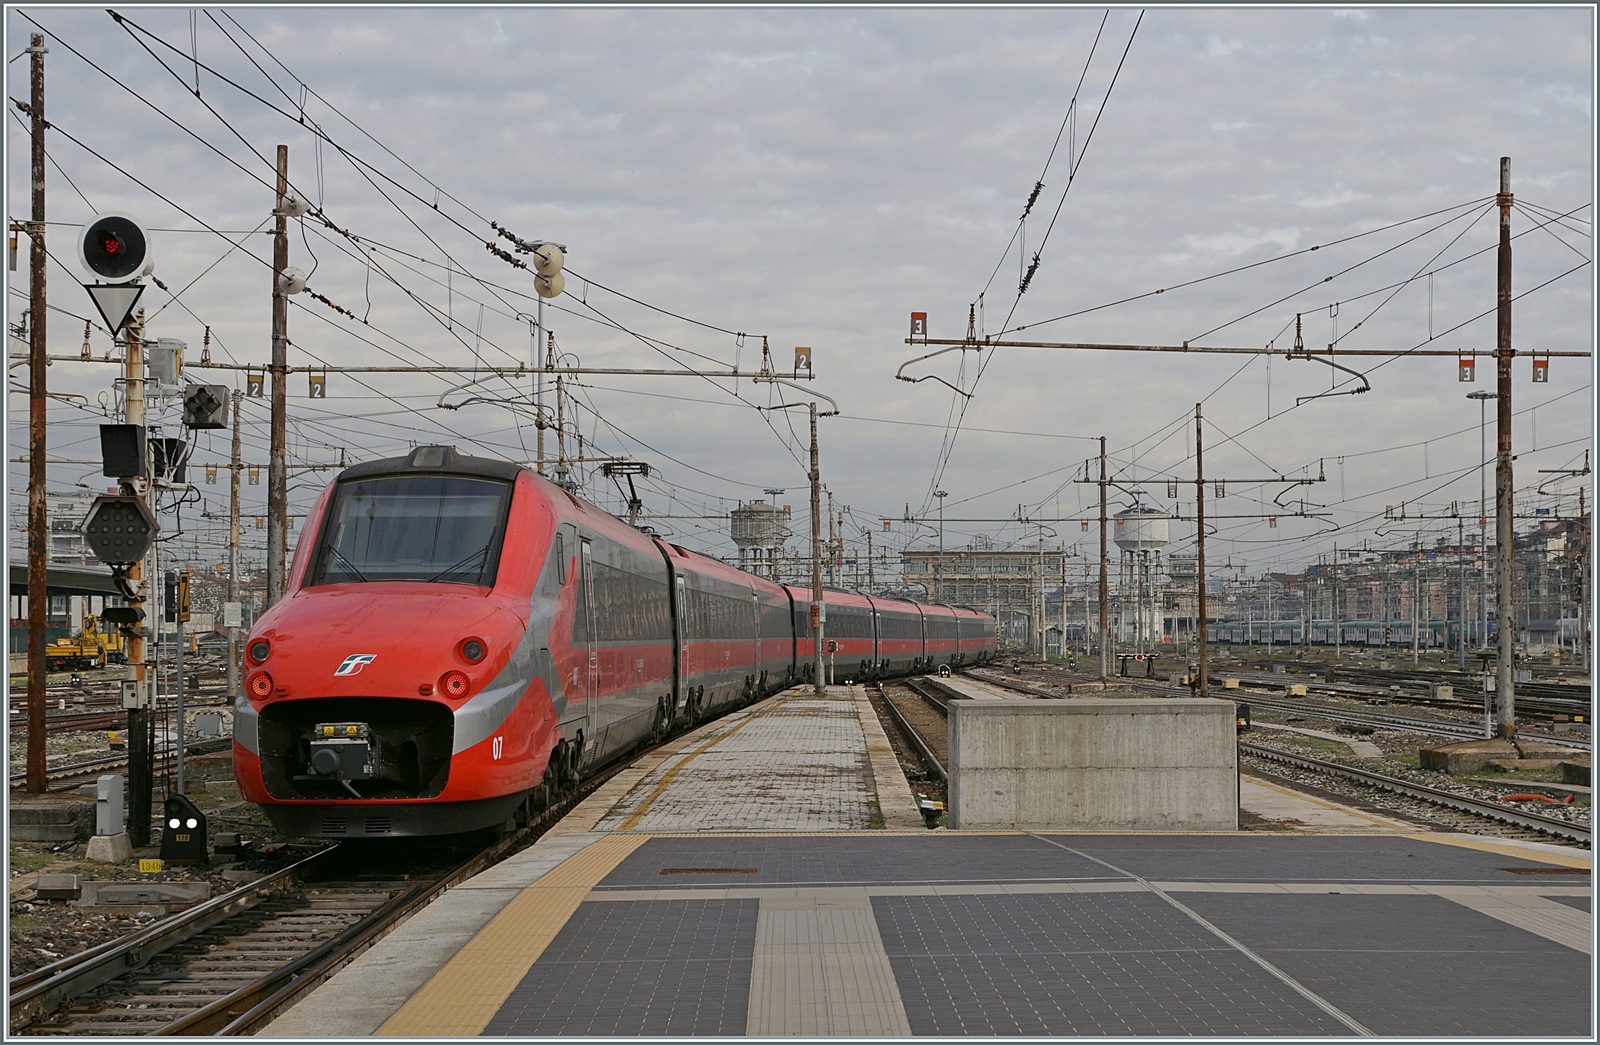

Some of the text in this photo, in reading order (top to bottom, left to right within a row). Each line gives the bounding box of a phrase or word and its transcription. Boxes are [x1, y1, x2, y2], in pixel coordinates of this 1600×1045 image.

[915, 319, 922, 334] 3
[800, 354, 807, 369] 2
[1463, 367, 1470, 381] 3
[1537, 367, 1544, 381] 3
[251, 382, 259, 397] 2
[313, 383, 321, 398] 2
[208, 475, 214, 484] 2
[251, 475, 257, 485] 2
[1170, 489, 1175, 498] 3
[1217, 489, 1223, 498] 3
[492, 736, 503, 761] 07
[141, 862, 161, 871] 134b
